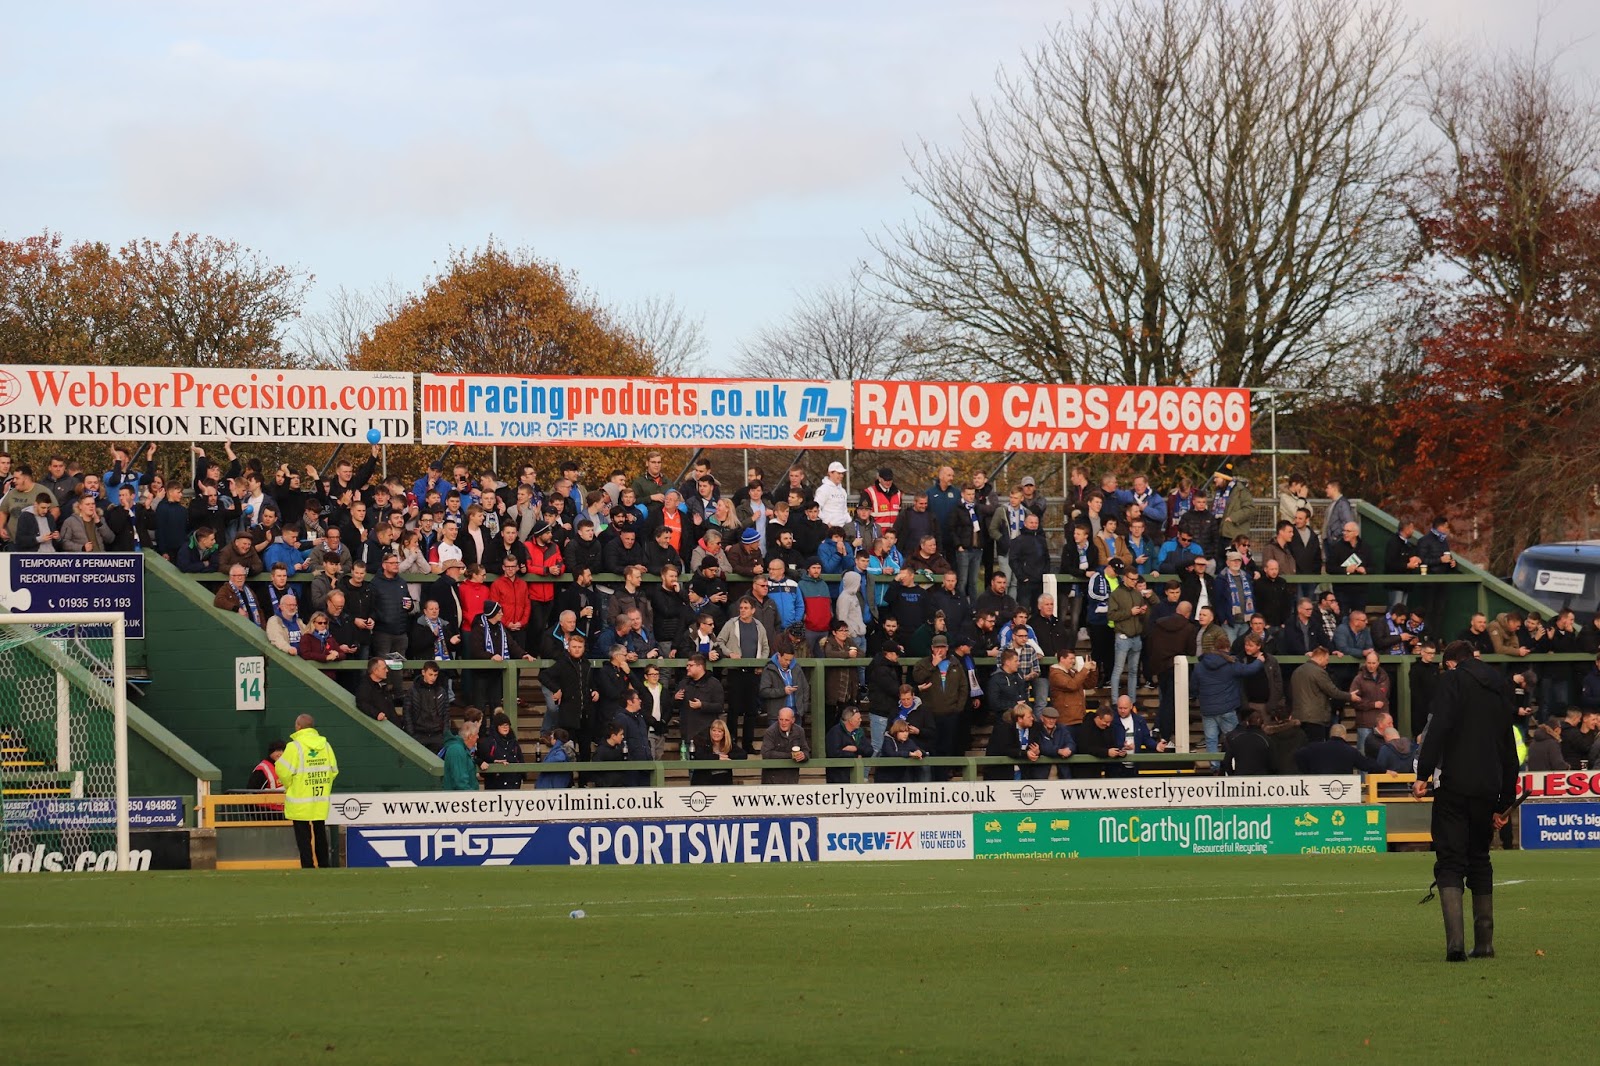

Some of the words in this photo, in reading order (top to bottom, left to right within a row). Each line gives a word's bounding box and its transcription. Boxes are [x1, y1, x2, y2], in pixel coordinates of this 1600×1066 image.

[26, 371, 407, 411] WebberPrecision.com
[424, 379, 787, 420] mdracingproducts.co.uk
[859, 383, 990, 429] RADIO
[1002, 385, 1110, 430] CABS
[1115, 389, 1246, 432] 426666
[65, 414, 189, 436] PRECISION
[200, 415, 357, 438] ENGINEERING
[425, 420, 459, 437] FOR
[463, 421, 494, 437] ALL
[500, 421, 542, 438] YOUR
[546, 422, 578, 438] OFF
[583, 422, 628, 439] ROAD
[632, 423, 735, 440] MOTOCROSS
[740, 424, 789, 440] NEEDS
[805, 429, 826, 439] UFO
[971, 430, 993, 449] &
[1004, 431, 1089, 451] AWAY
[1099, 432, 1130, 451] IN
[1137, 433, 1156, 452] A
[20, 558, 73, 568] TEMPORARY
[74, 558, 82, 568] &
[83, 558, 136, 568] PERMANENT
[20, 573, 80, 583] RECRUITMENT
[82, 573, 136, 583] SPECIALISTS
[59, 597, 88, 608] 01935
[93, 597, 111, 608] 513
[114, 597, 131, 608] 193
[239, 661, 261, 674] GATE
[240, 677, 261, 702] 14
[312, 786, 324, 797] 157
[732, 785, 996, 809] www.westerlyyeovilmini.co.uk
[1061, 780, 1310, 803] www.westerlyyeovilmini.co.uk
[48, 802, 75, 813] 01935
[77, 801, 109, 812] 471828
[145, 800, 176, 810] 494862
[382, 791, 664, 816] www.westerlyyeovilmini.co.uk
[1537, 814, 1557, 826] The
[1559, 814, 1583, 826] UK's
[920, 831, 938, 840] HERE
[940, 830, 962, 839] WHEN
[1099, 816, 1190, 848] McCarthy
[1195, 814, 1271, 840] Marland
[1541, 830, 1572, 841] Proud
[1574, 831, 1585, 840] to
[568, 822, 811, 865] SPORTSWEAR
[827, 831, 915, 855] SCREWFIX
[920, 840, 935, 849] YOU
[936, 840, 955, 849] NEED
[957, 839, 966, 848] US
[1193, 843, 1234, 854] Resourceful
[1235, 842, 1268, 854] Recycling
[1321, 846, 1346, 854] 01458
[1347, 845, 1376, 854] 274654
